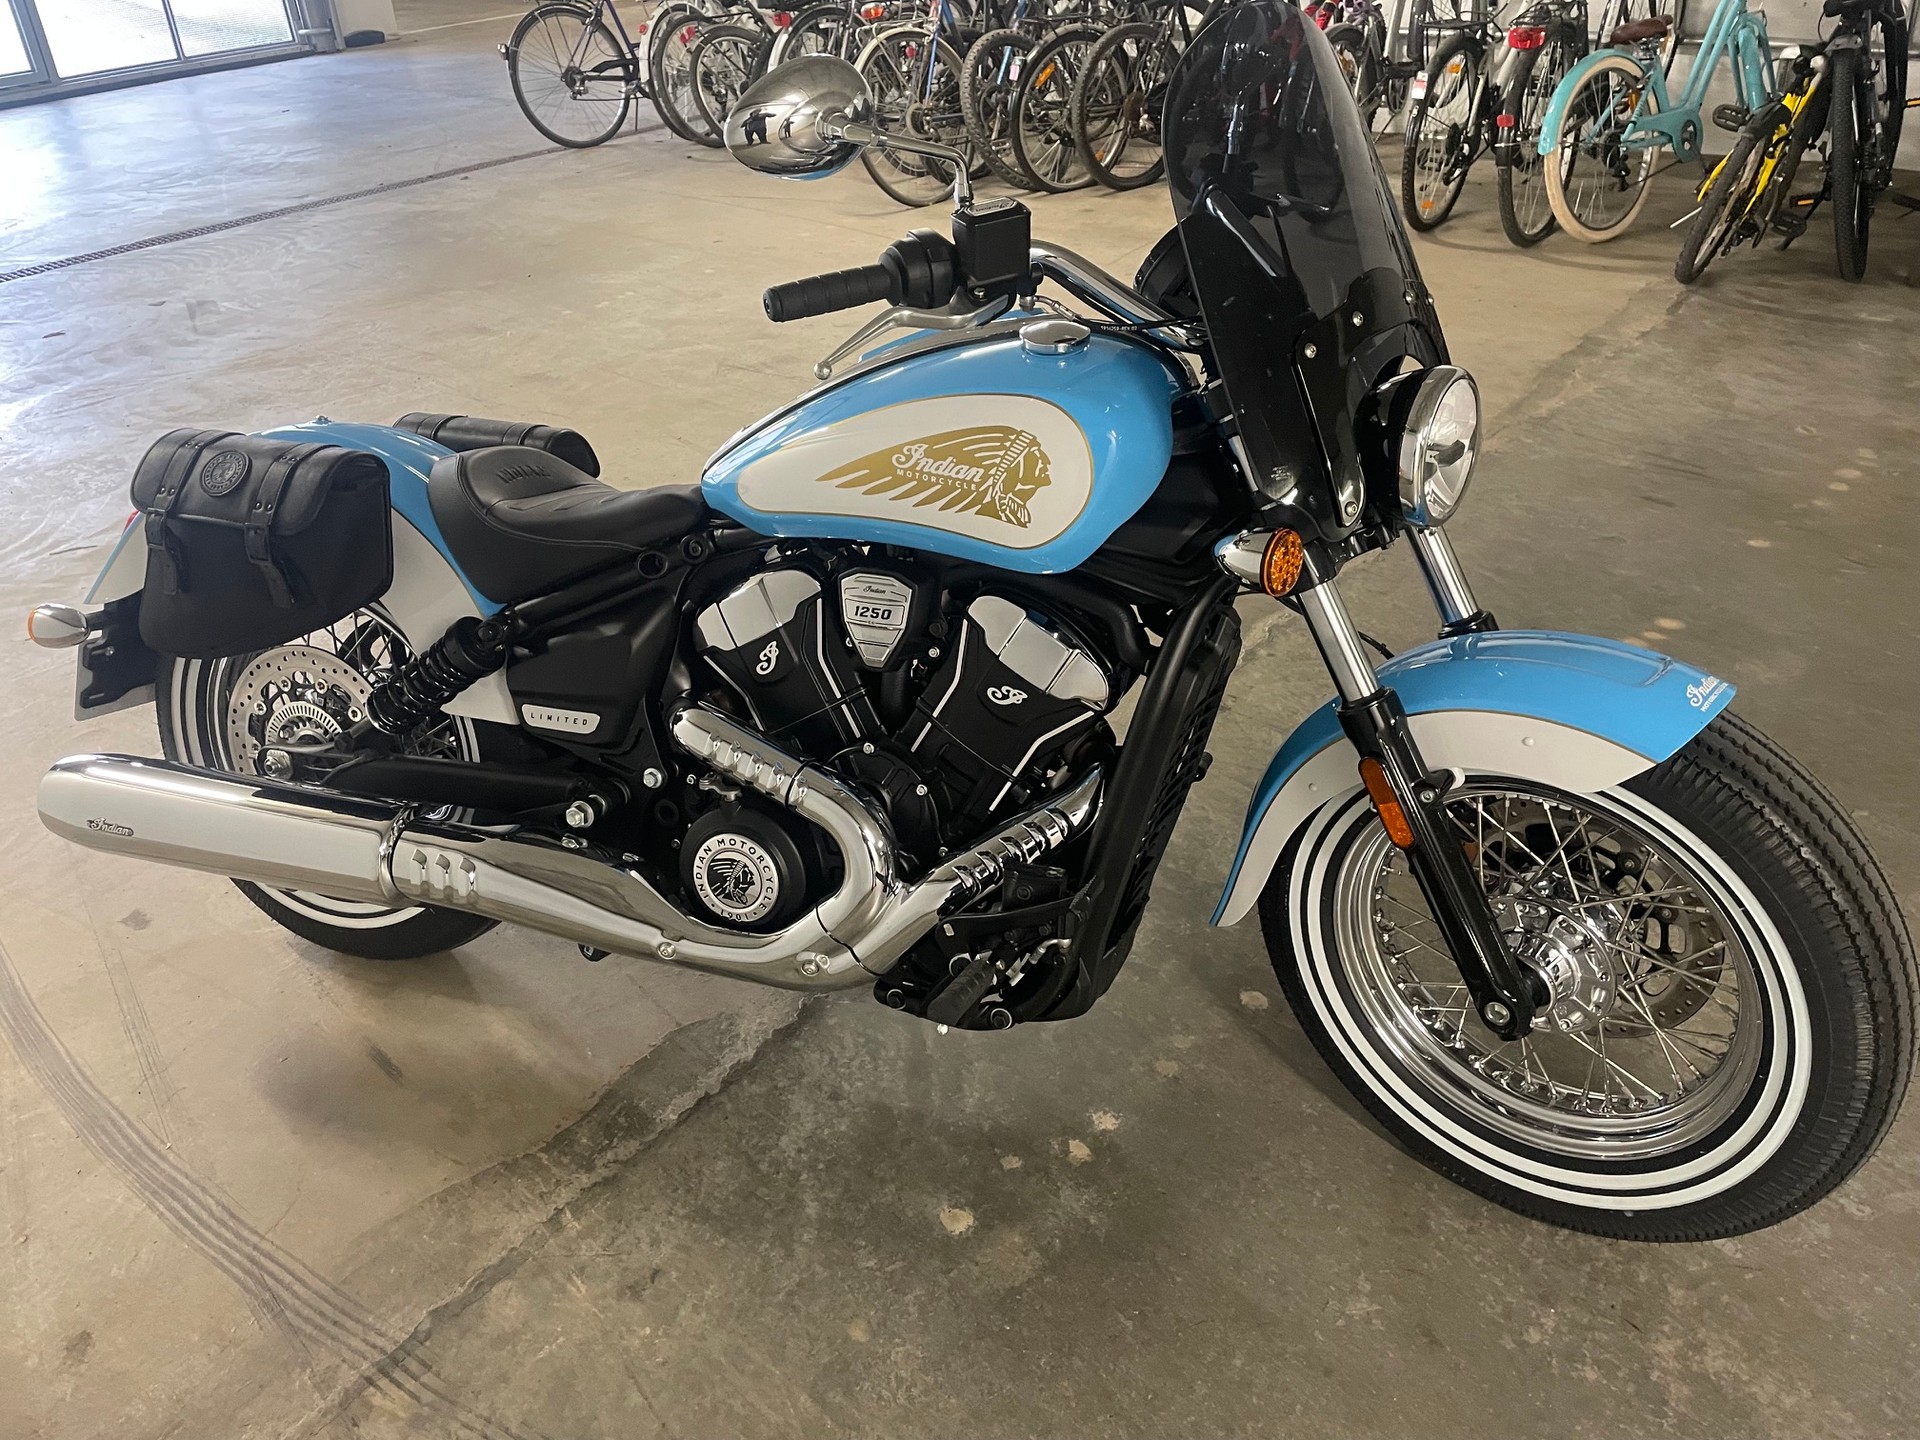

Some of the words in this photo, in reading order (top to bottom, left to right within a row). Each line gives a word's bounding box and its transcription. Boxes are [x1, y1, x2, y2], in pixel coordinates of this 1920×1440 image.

[891, 443, 983, 483] Indian
[896, 468, 977, 491] MOTORCYCLE
[863, 585, 887, 595] Indian
[854, 605, 892, 620] 1250
[530, 712, 588, 726] LIMITED
[88, 816, 131, 836] Indian
[695, 845, 713, 899] INDIAN
[717, 838, 775, 911] MOTORCYCLE
[720, 908, 749, 921] 1901
